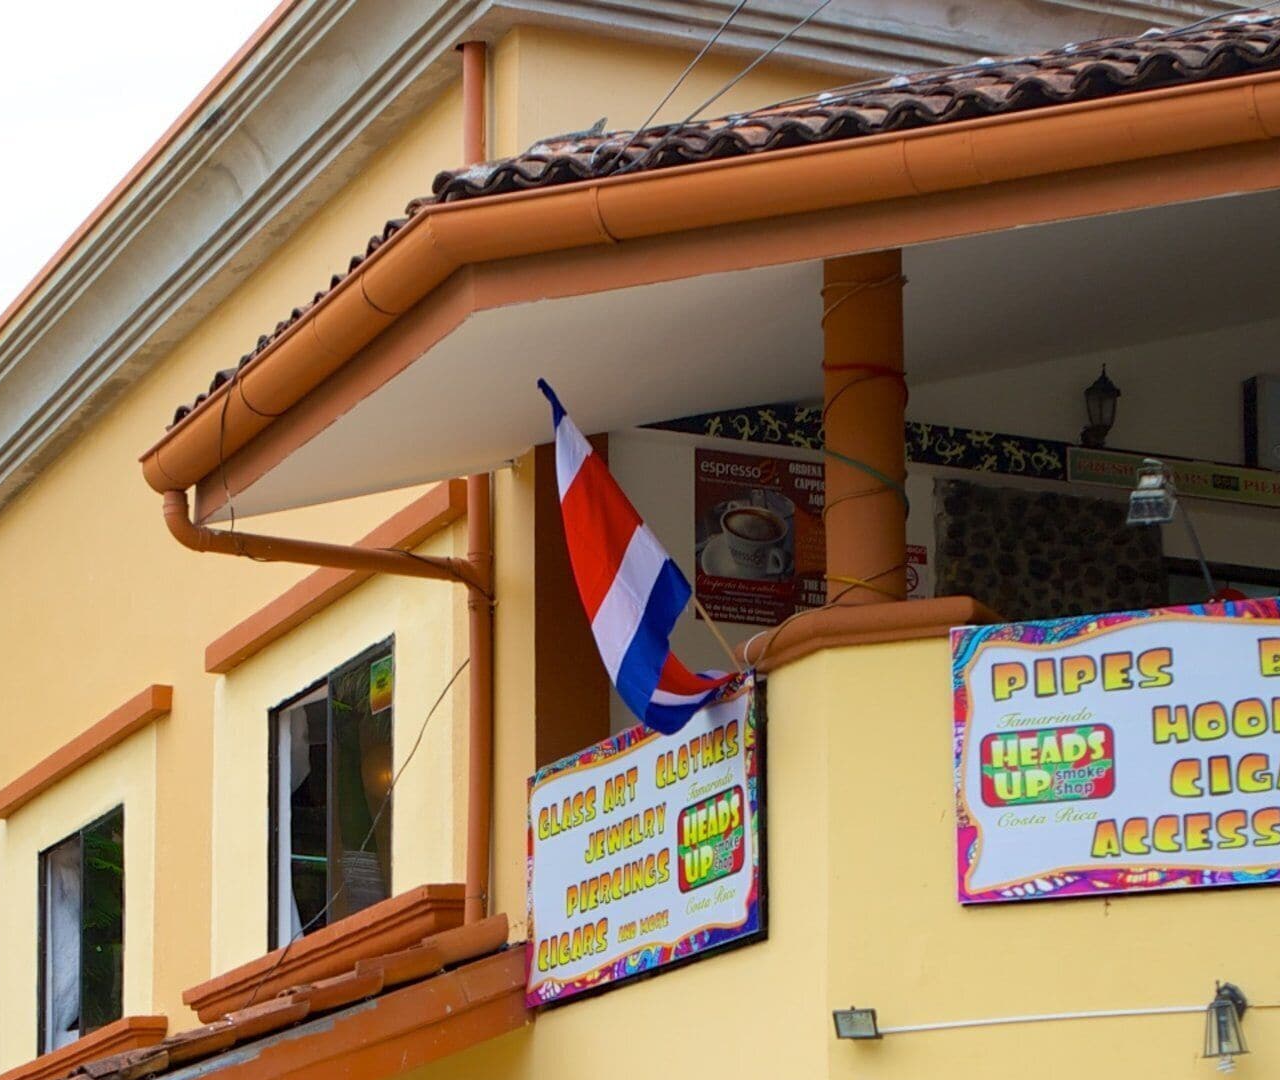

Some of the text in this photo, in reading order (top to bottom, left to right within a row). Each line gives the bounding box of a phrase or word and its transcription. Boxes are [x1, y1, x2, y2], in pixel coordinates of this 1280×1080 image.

[700, 459, 762, 479] espresso
[992, 647, 1174, 701] PIPES
[996, 707, 1093, 729] Tamarindo
[990, 731, 1106, 768] HEADS
[538, 719, 739, 841] GLASS ART CLOTHES
[686, 767, 733, 802] Tamarindo
[993, 765, 1106, 801] UP smoke
[1055, 780, 1094, 796] shop
[584, 802, 666, 863] JEWELRY
[683, 797, 740, 846] HEADS
[996, 806, 1099, 829] Costa Rica
[684, 836, 740, 883] UP smoke
[566, 847, 670, 918] PIERCINGS
[685, 898, 712, 916] Costa
[537, 909, 670, 972] CIGARS AND MORE
